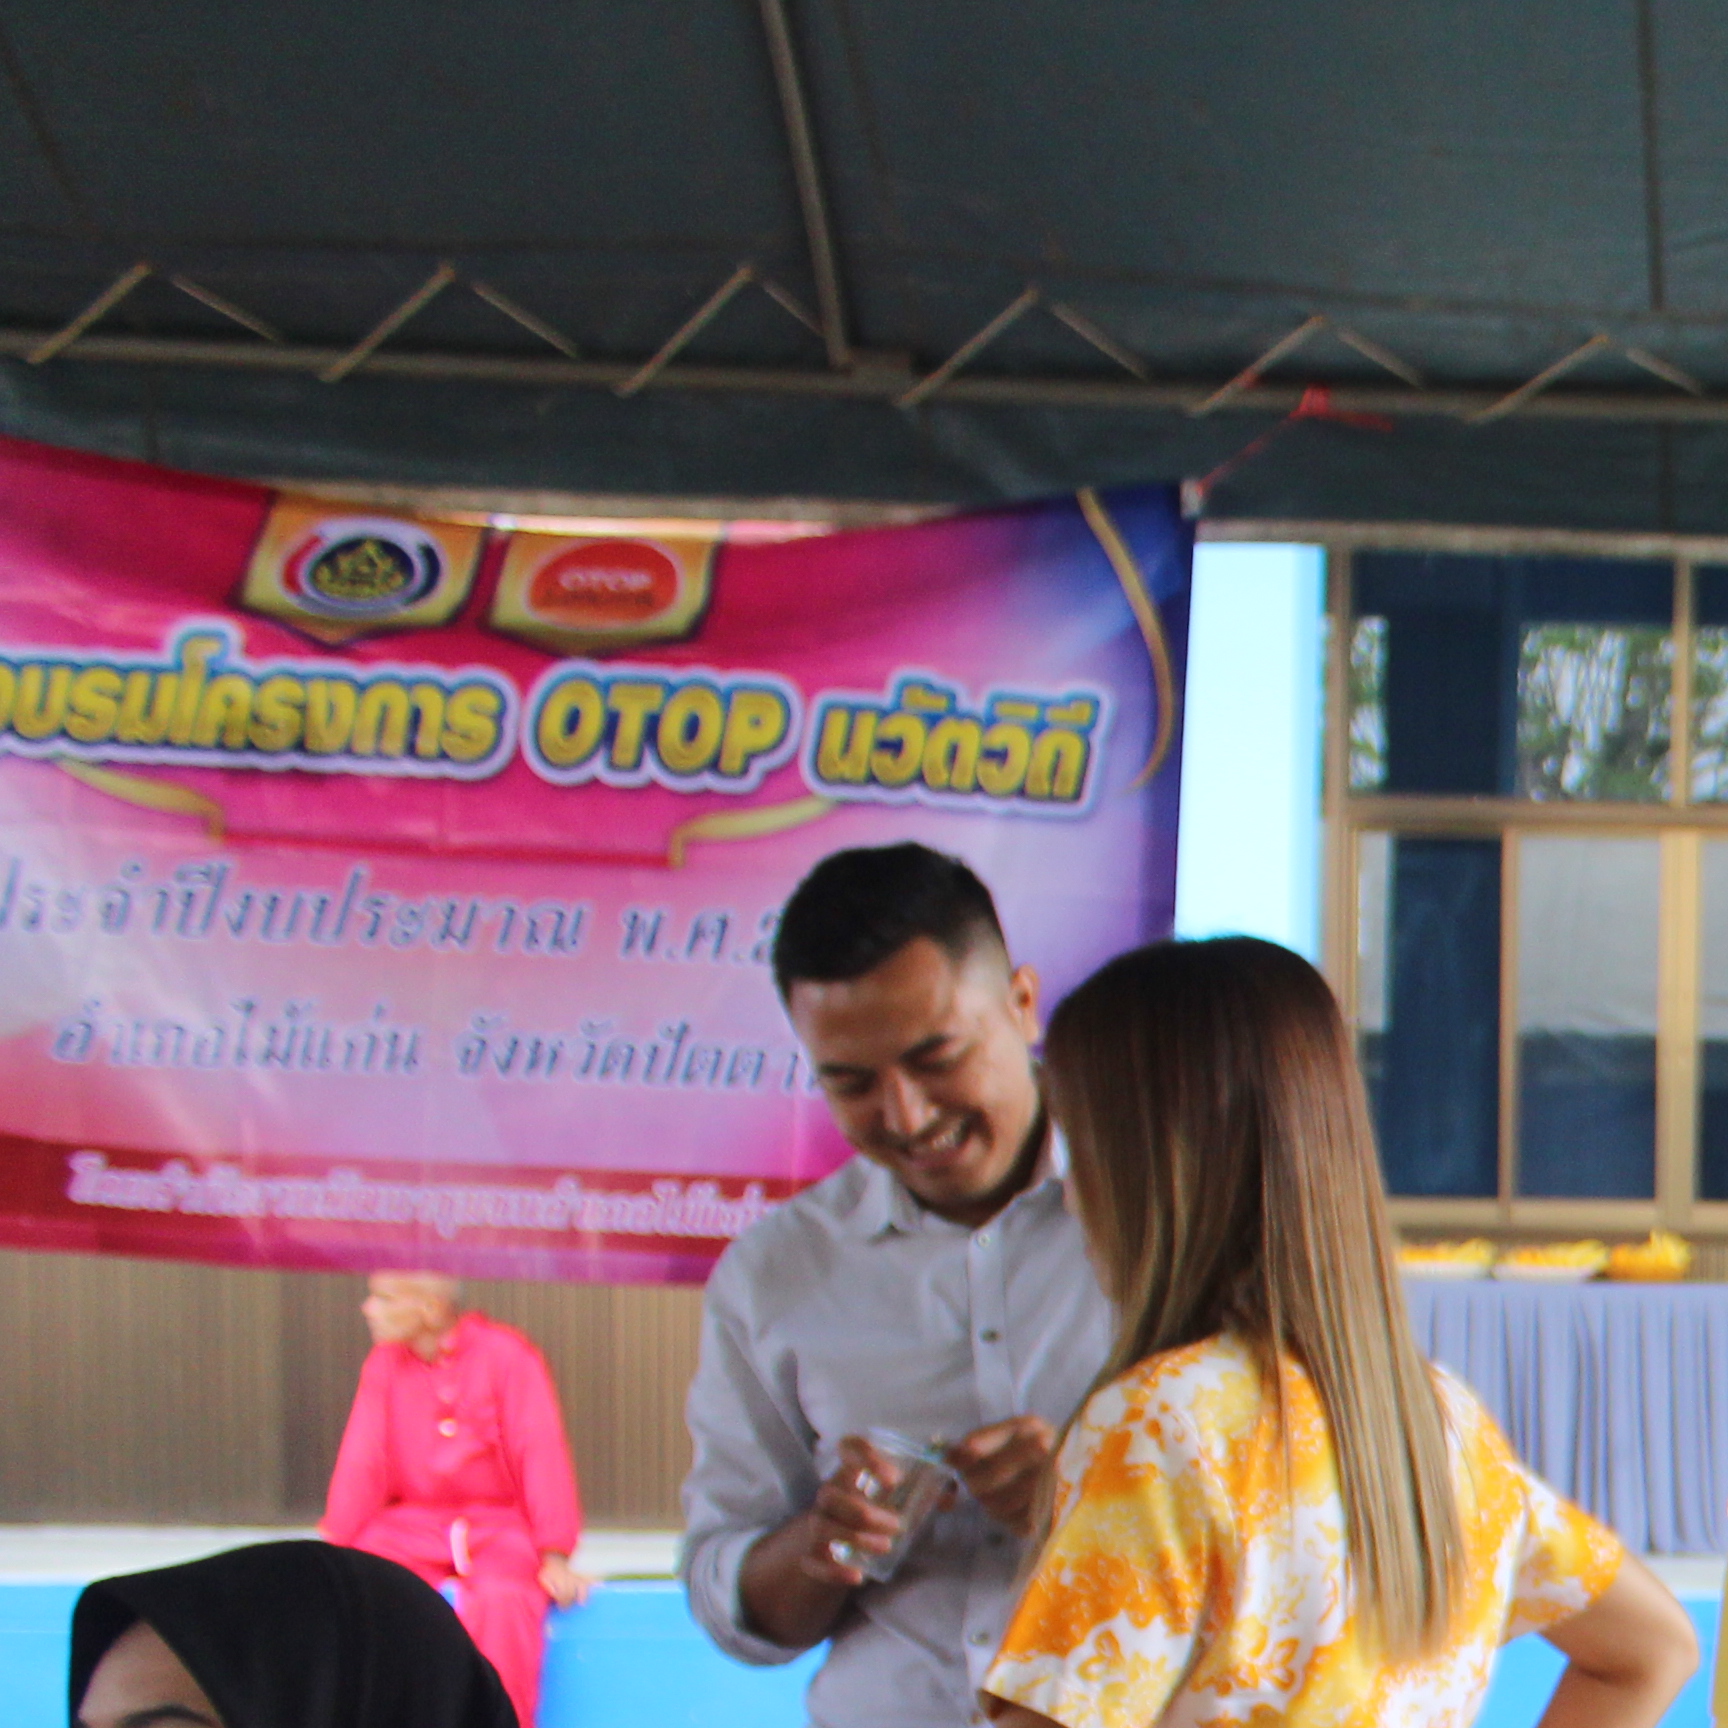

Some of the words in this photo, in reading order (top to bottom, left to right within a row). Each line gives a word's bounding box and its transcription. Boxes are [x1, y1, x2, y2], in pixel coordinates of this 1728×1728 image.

[535, 676, 790, 778] OTOP
[813, 682, 1098, 801] นวัตวิถี
[621, 903, 781, 962] พ.ศ.2
[53, 998, 420, 1075] อำเภอไม้แก่น
[455, 1013, 818, 1092] จังหวัดปัตตา
